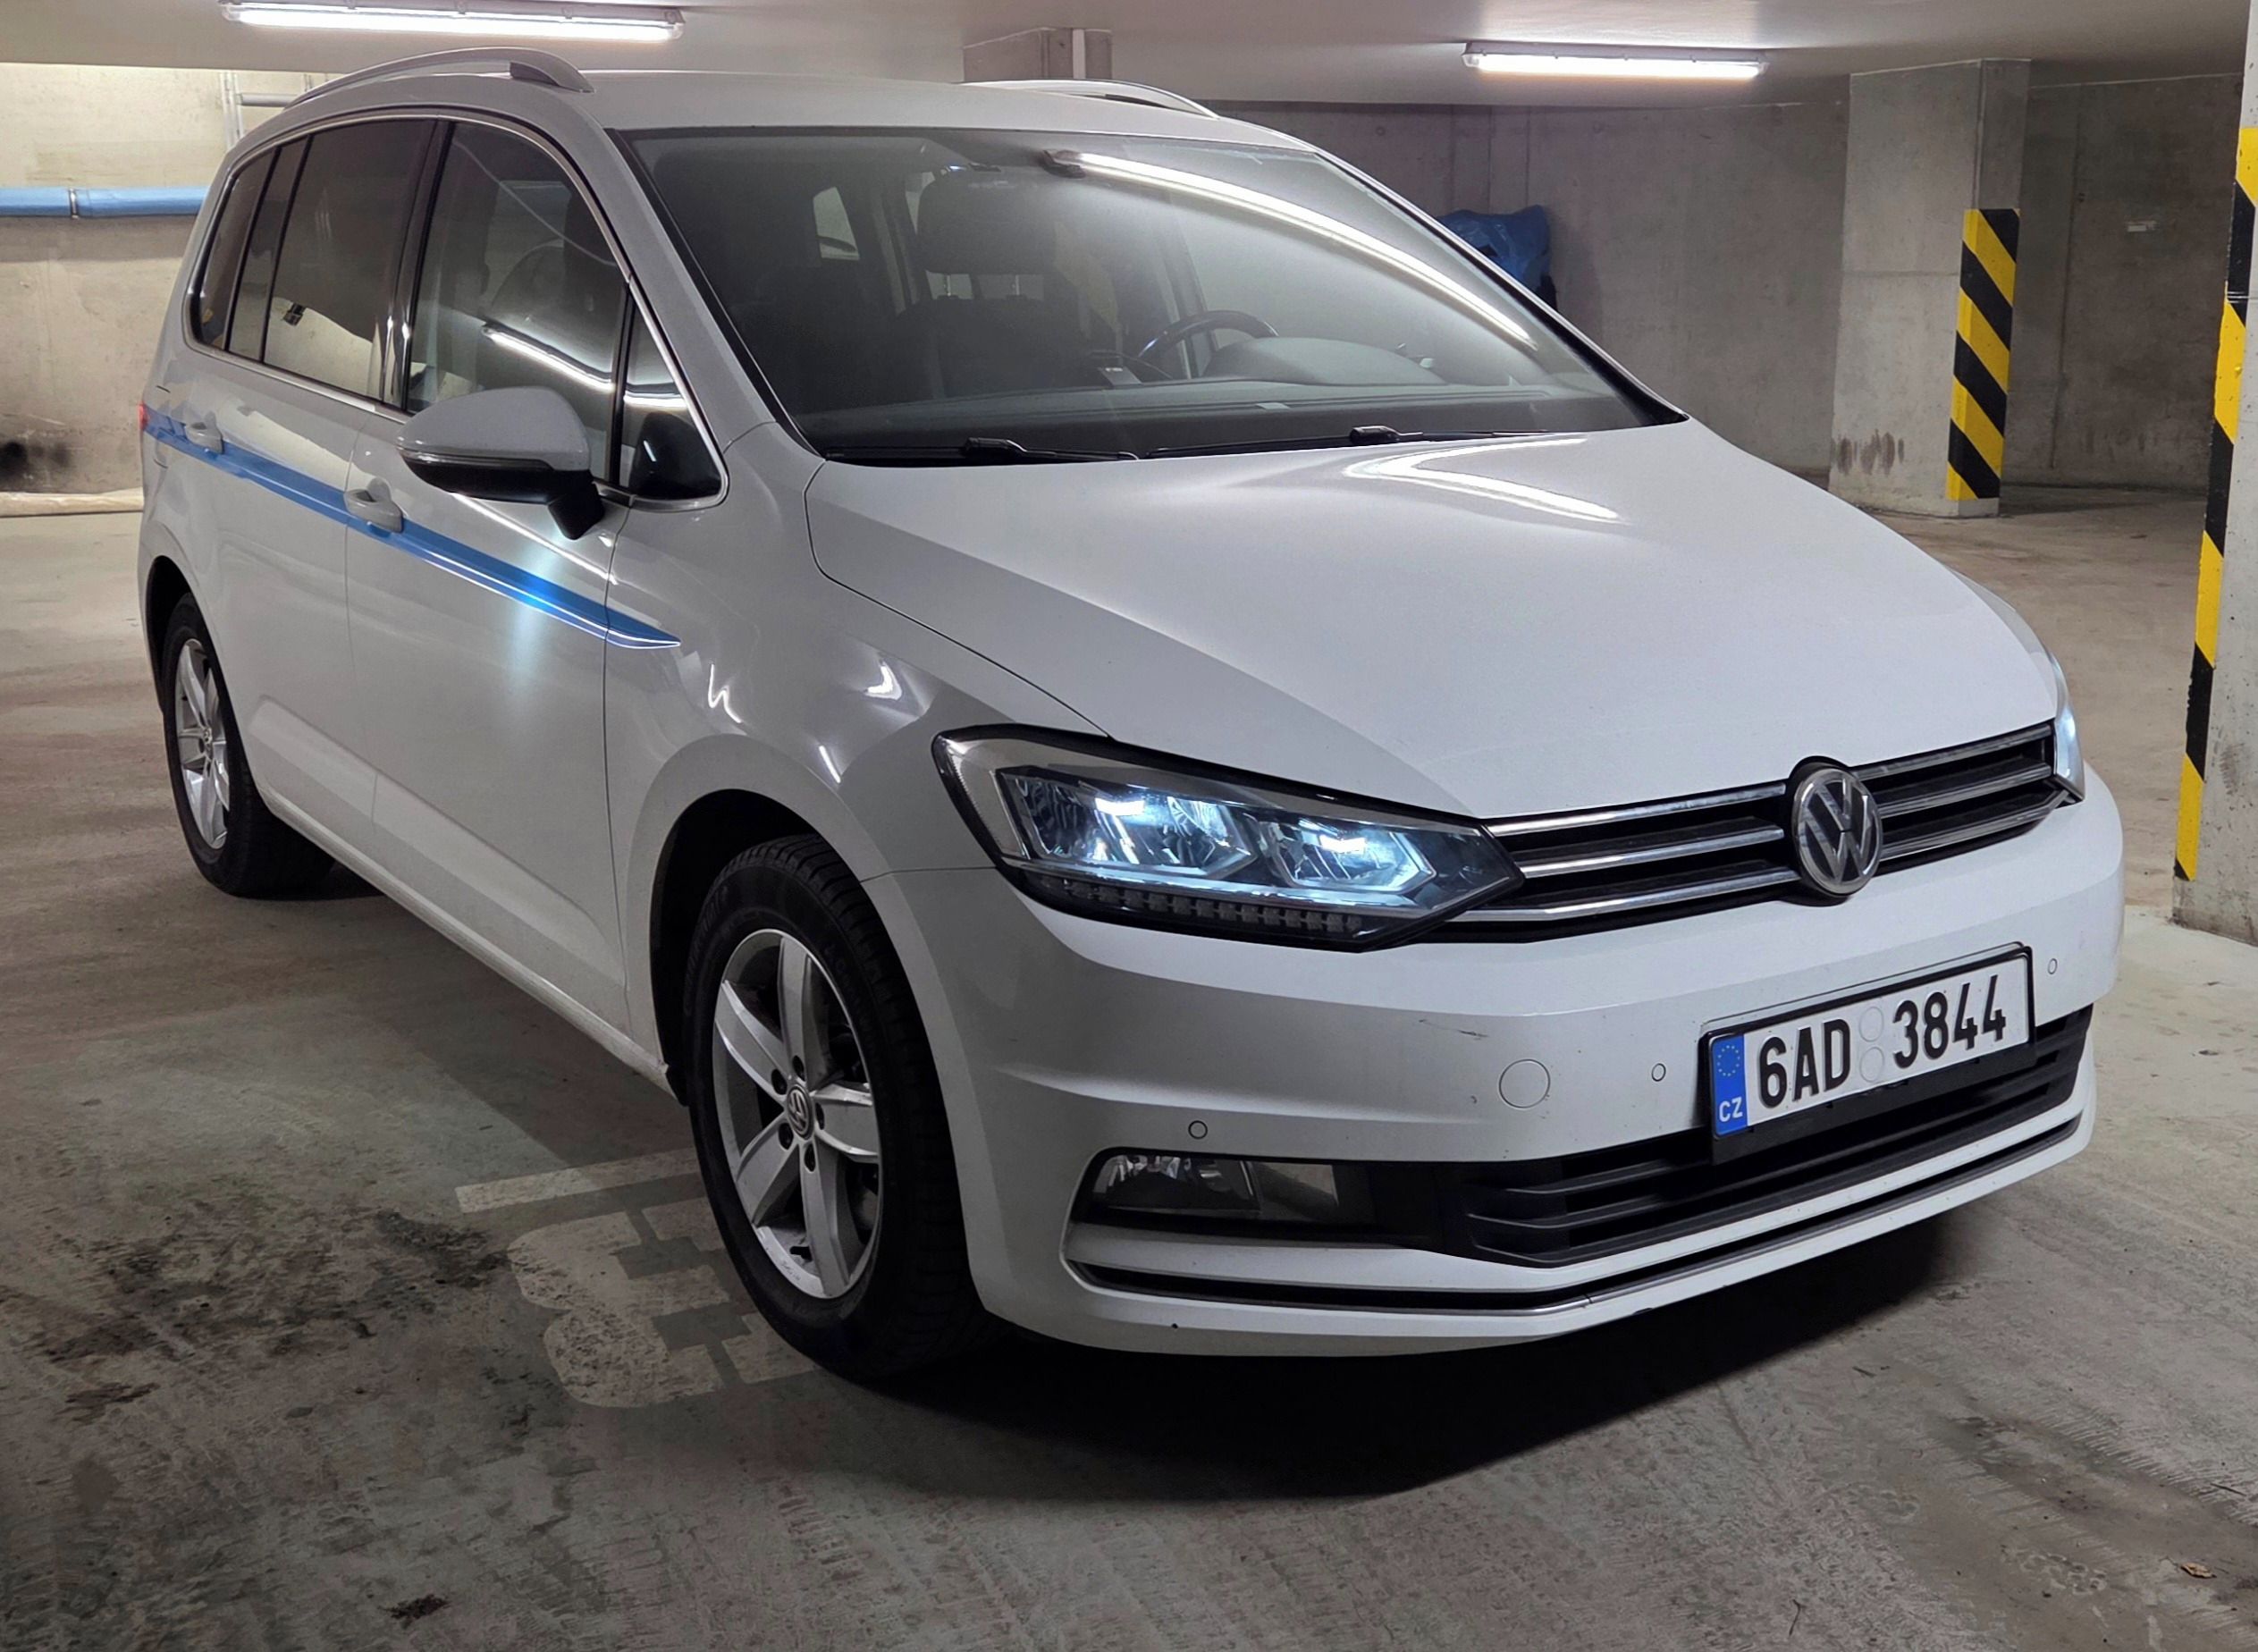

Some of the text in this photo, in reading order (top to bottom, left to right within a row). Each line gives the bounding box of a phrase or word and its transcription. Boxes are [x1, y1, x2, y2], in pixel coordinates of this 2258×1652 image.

[1795, 770, 1877, 892] VW
[1758, 974, 2007, 1109] 6AD 3844
[1718, 1096, 1744, 1123] CZ
